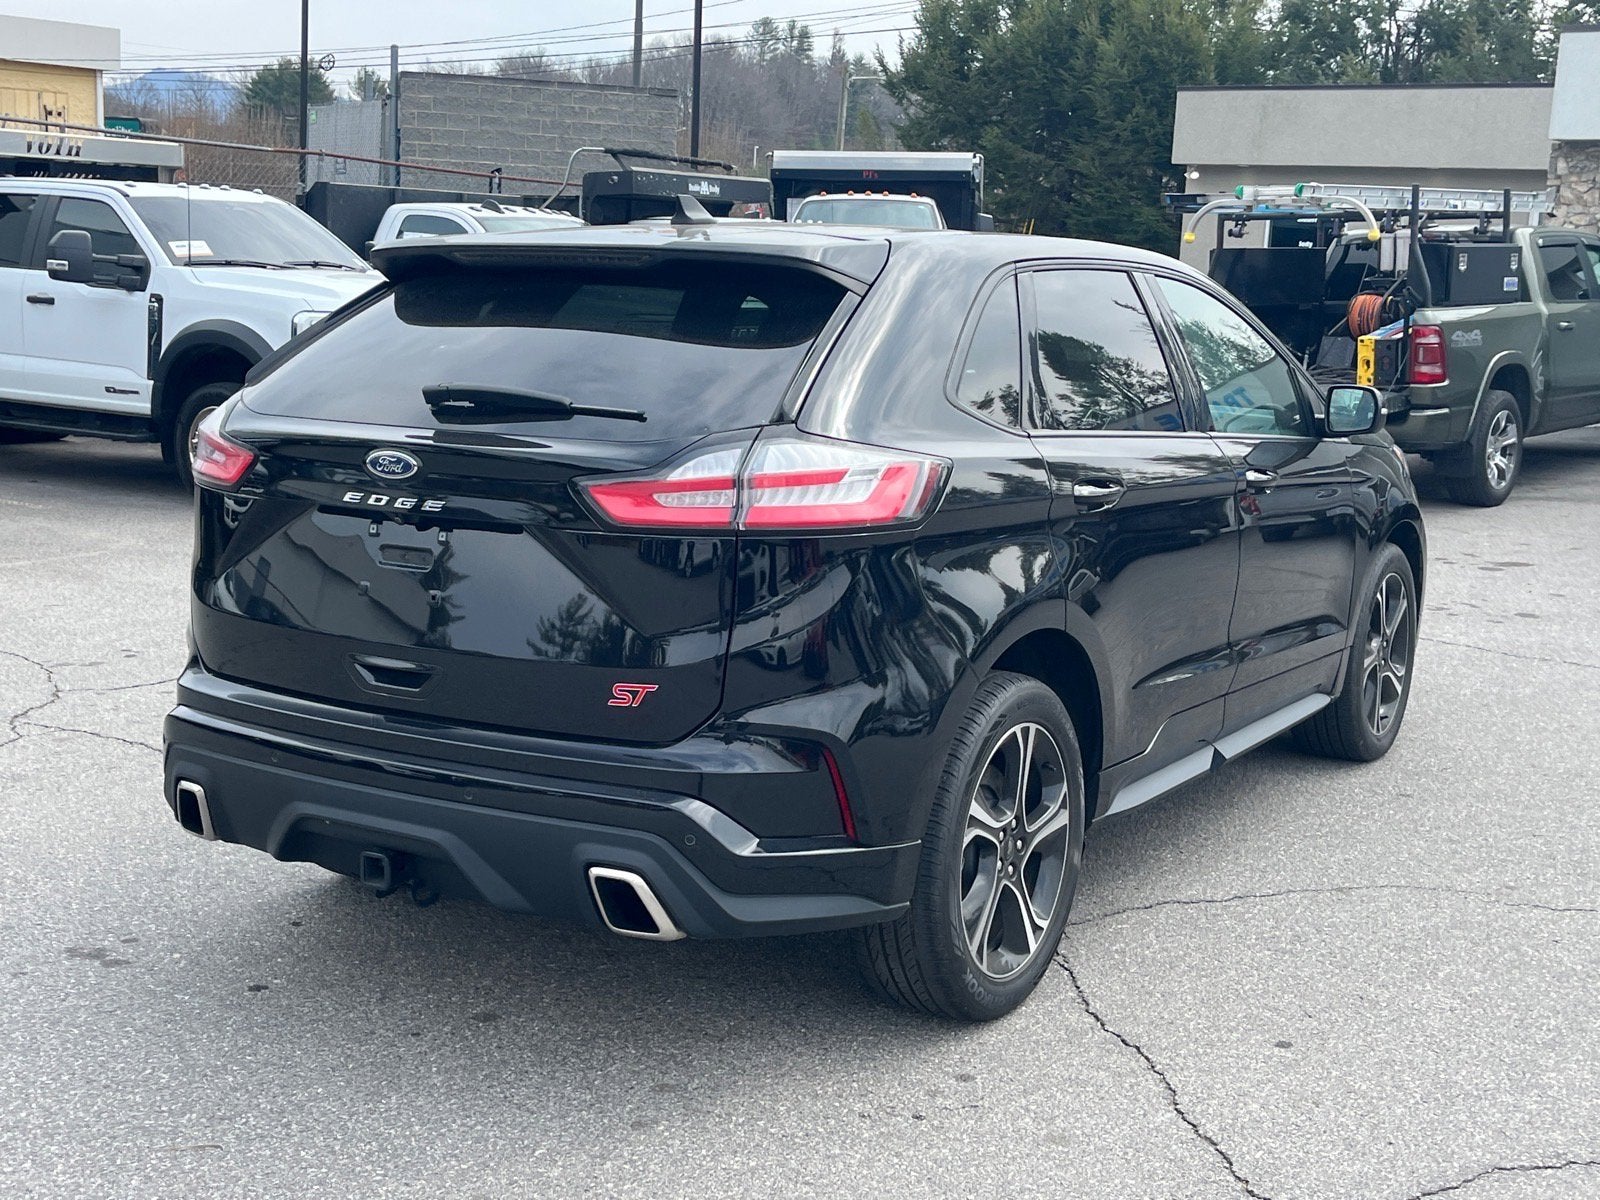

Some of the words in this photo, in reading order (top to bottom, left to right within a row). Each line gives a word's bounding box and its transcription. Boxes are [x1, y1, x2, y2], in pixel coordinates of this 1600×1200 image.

[376, 456, 404, 473] Ford
[342, 491, 446, 511] EDGE
[607, 683, 659, 707] ST
